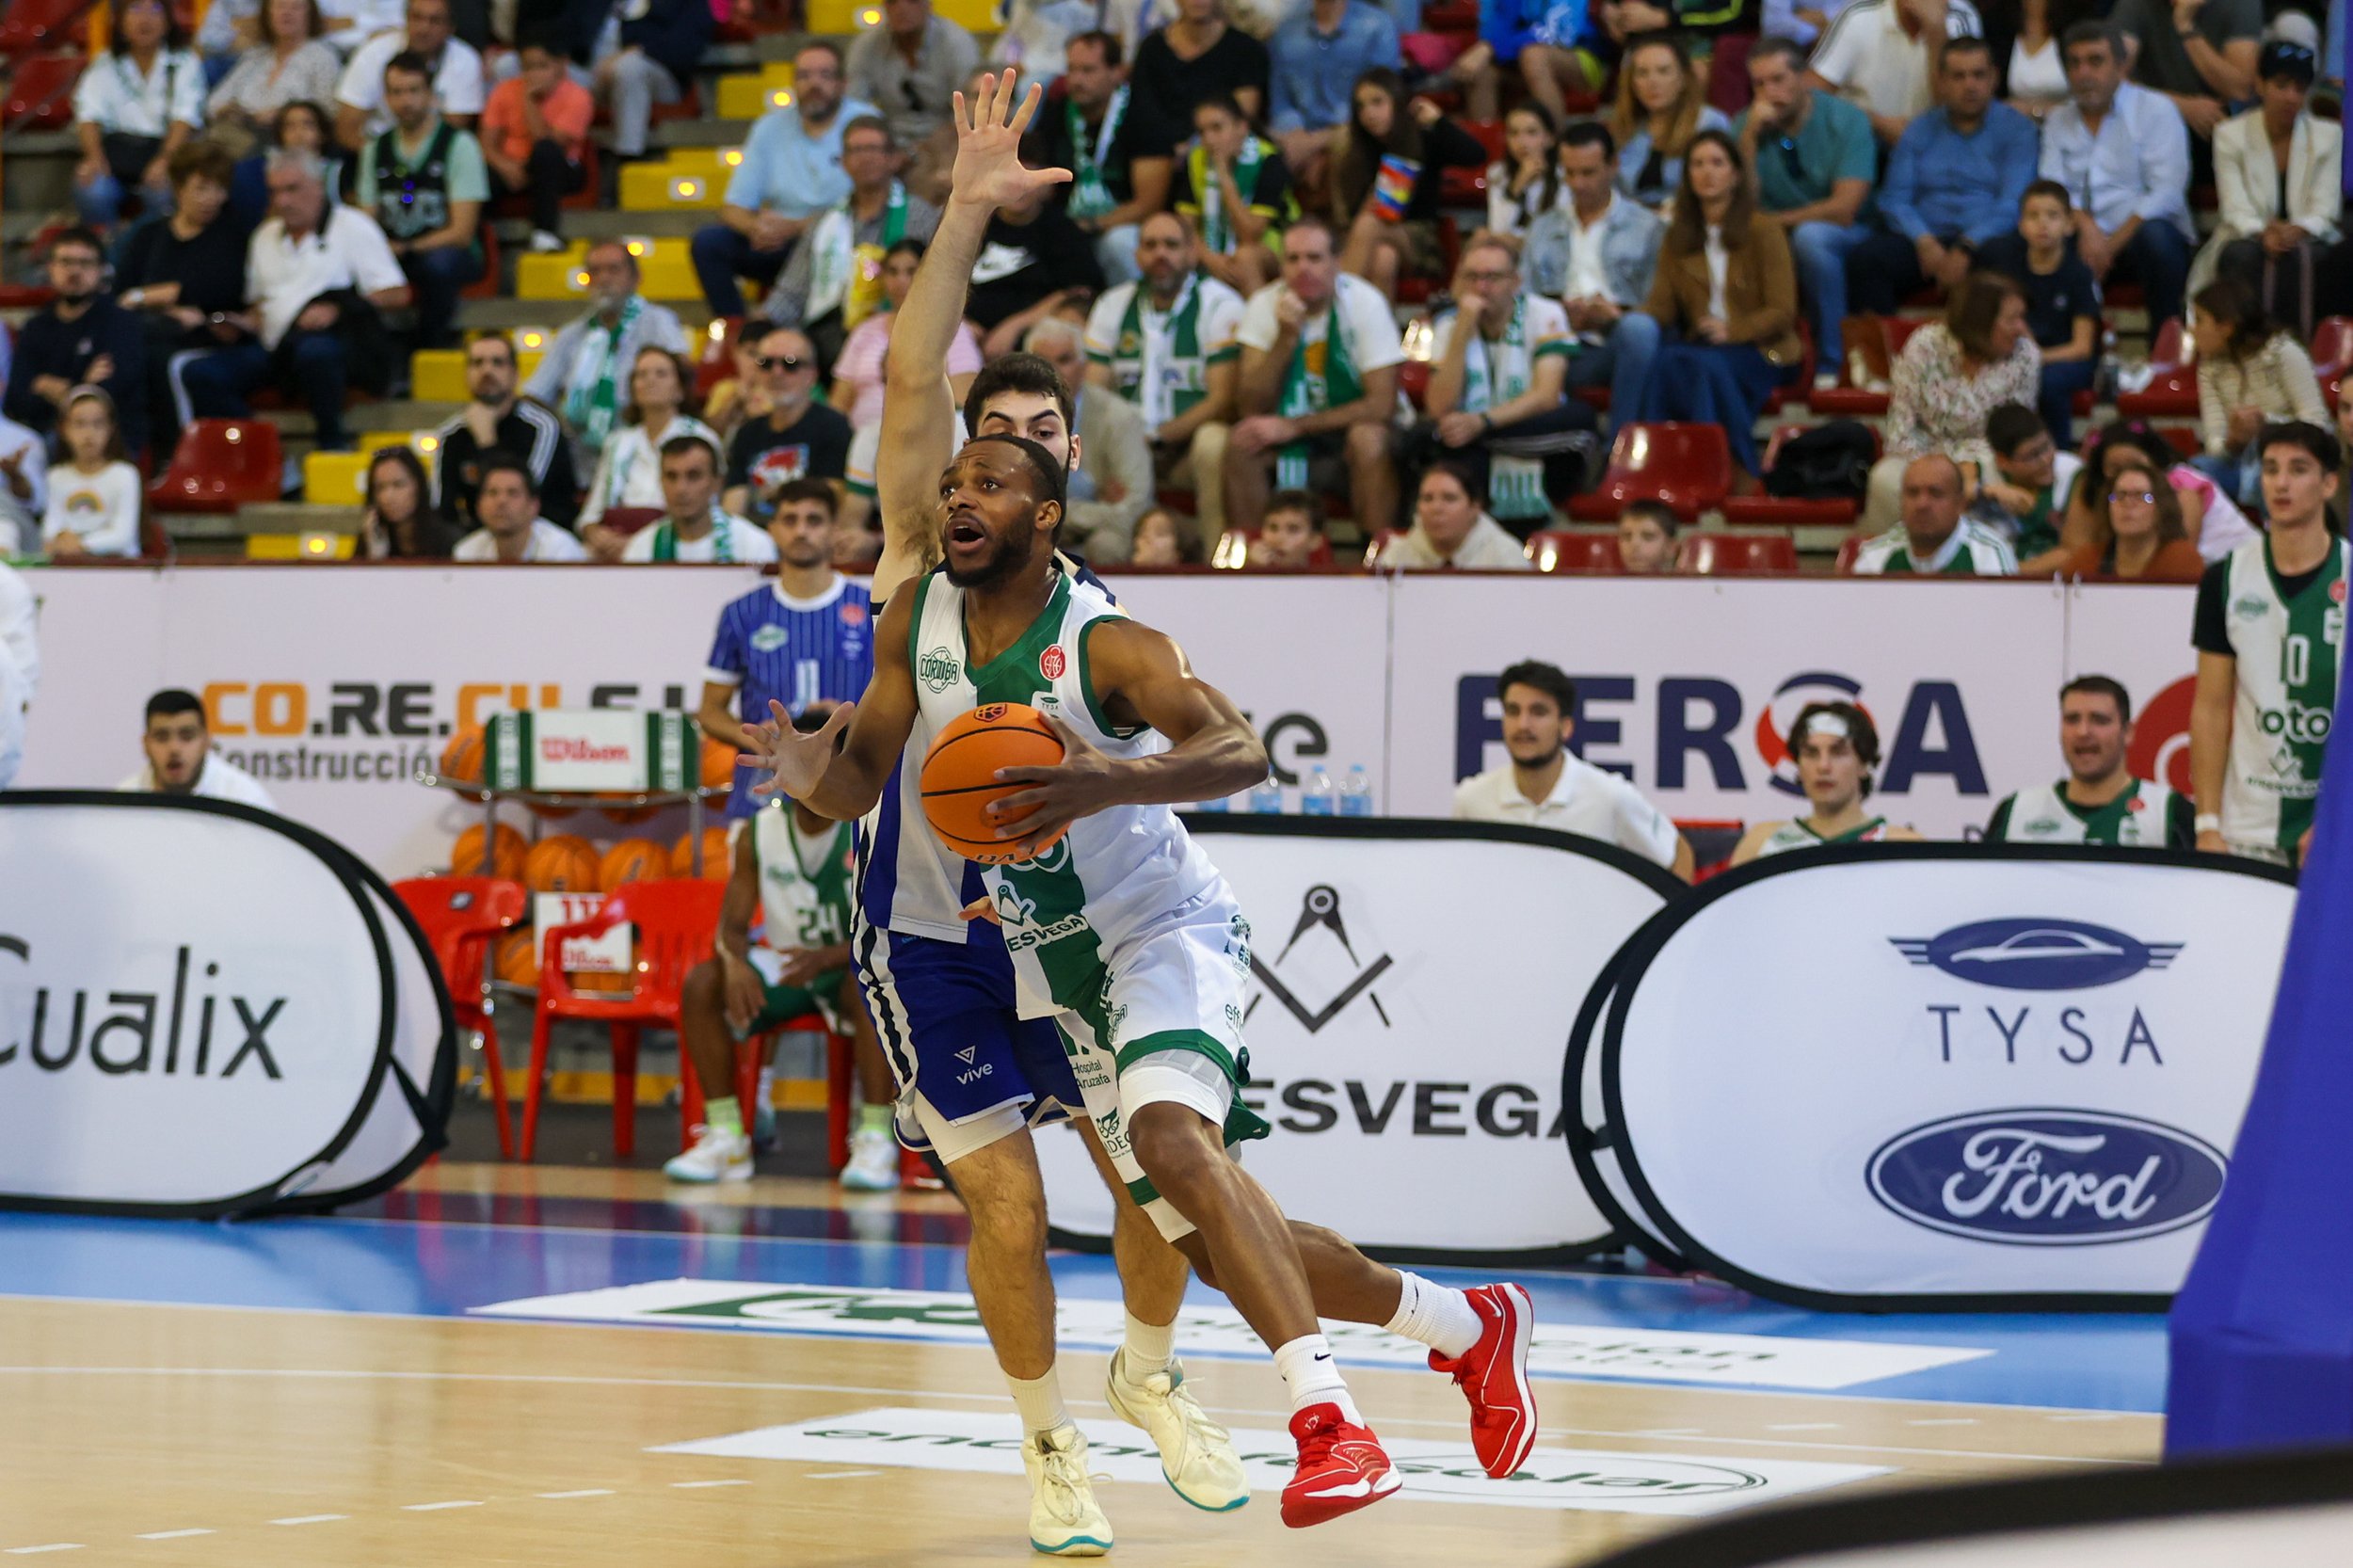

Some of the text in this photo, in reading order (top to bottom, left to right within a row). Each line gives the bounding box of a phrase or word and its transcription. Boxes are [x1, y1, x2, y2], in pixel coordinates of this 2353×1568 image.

[797, 904, 843, 946] 24
[1927, 1003, 2163, 1065] TYSA
[955, 1063, 994, 1085] vive
[1071, 1059, 1103, 1075] Hospital
[1075, 1074, 1111, 1090] Aruzafa
[1245, 1079, 1566, 1140] SVEG
[1942, 1128, 2161, 1221] Ford
